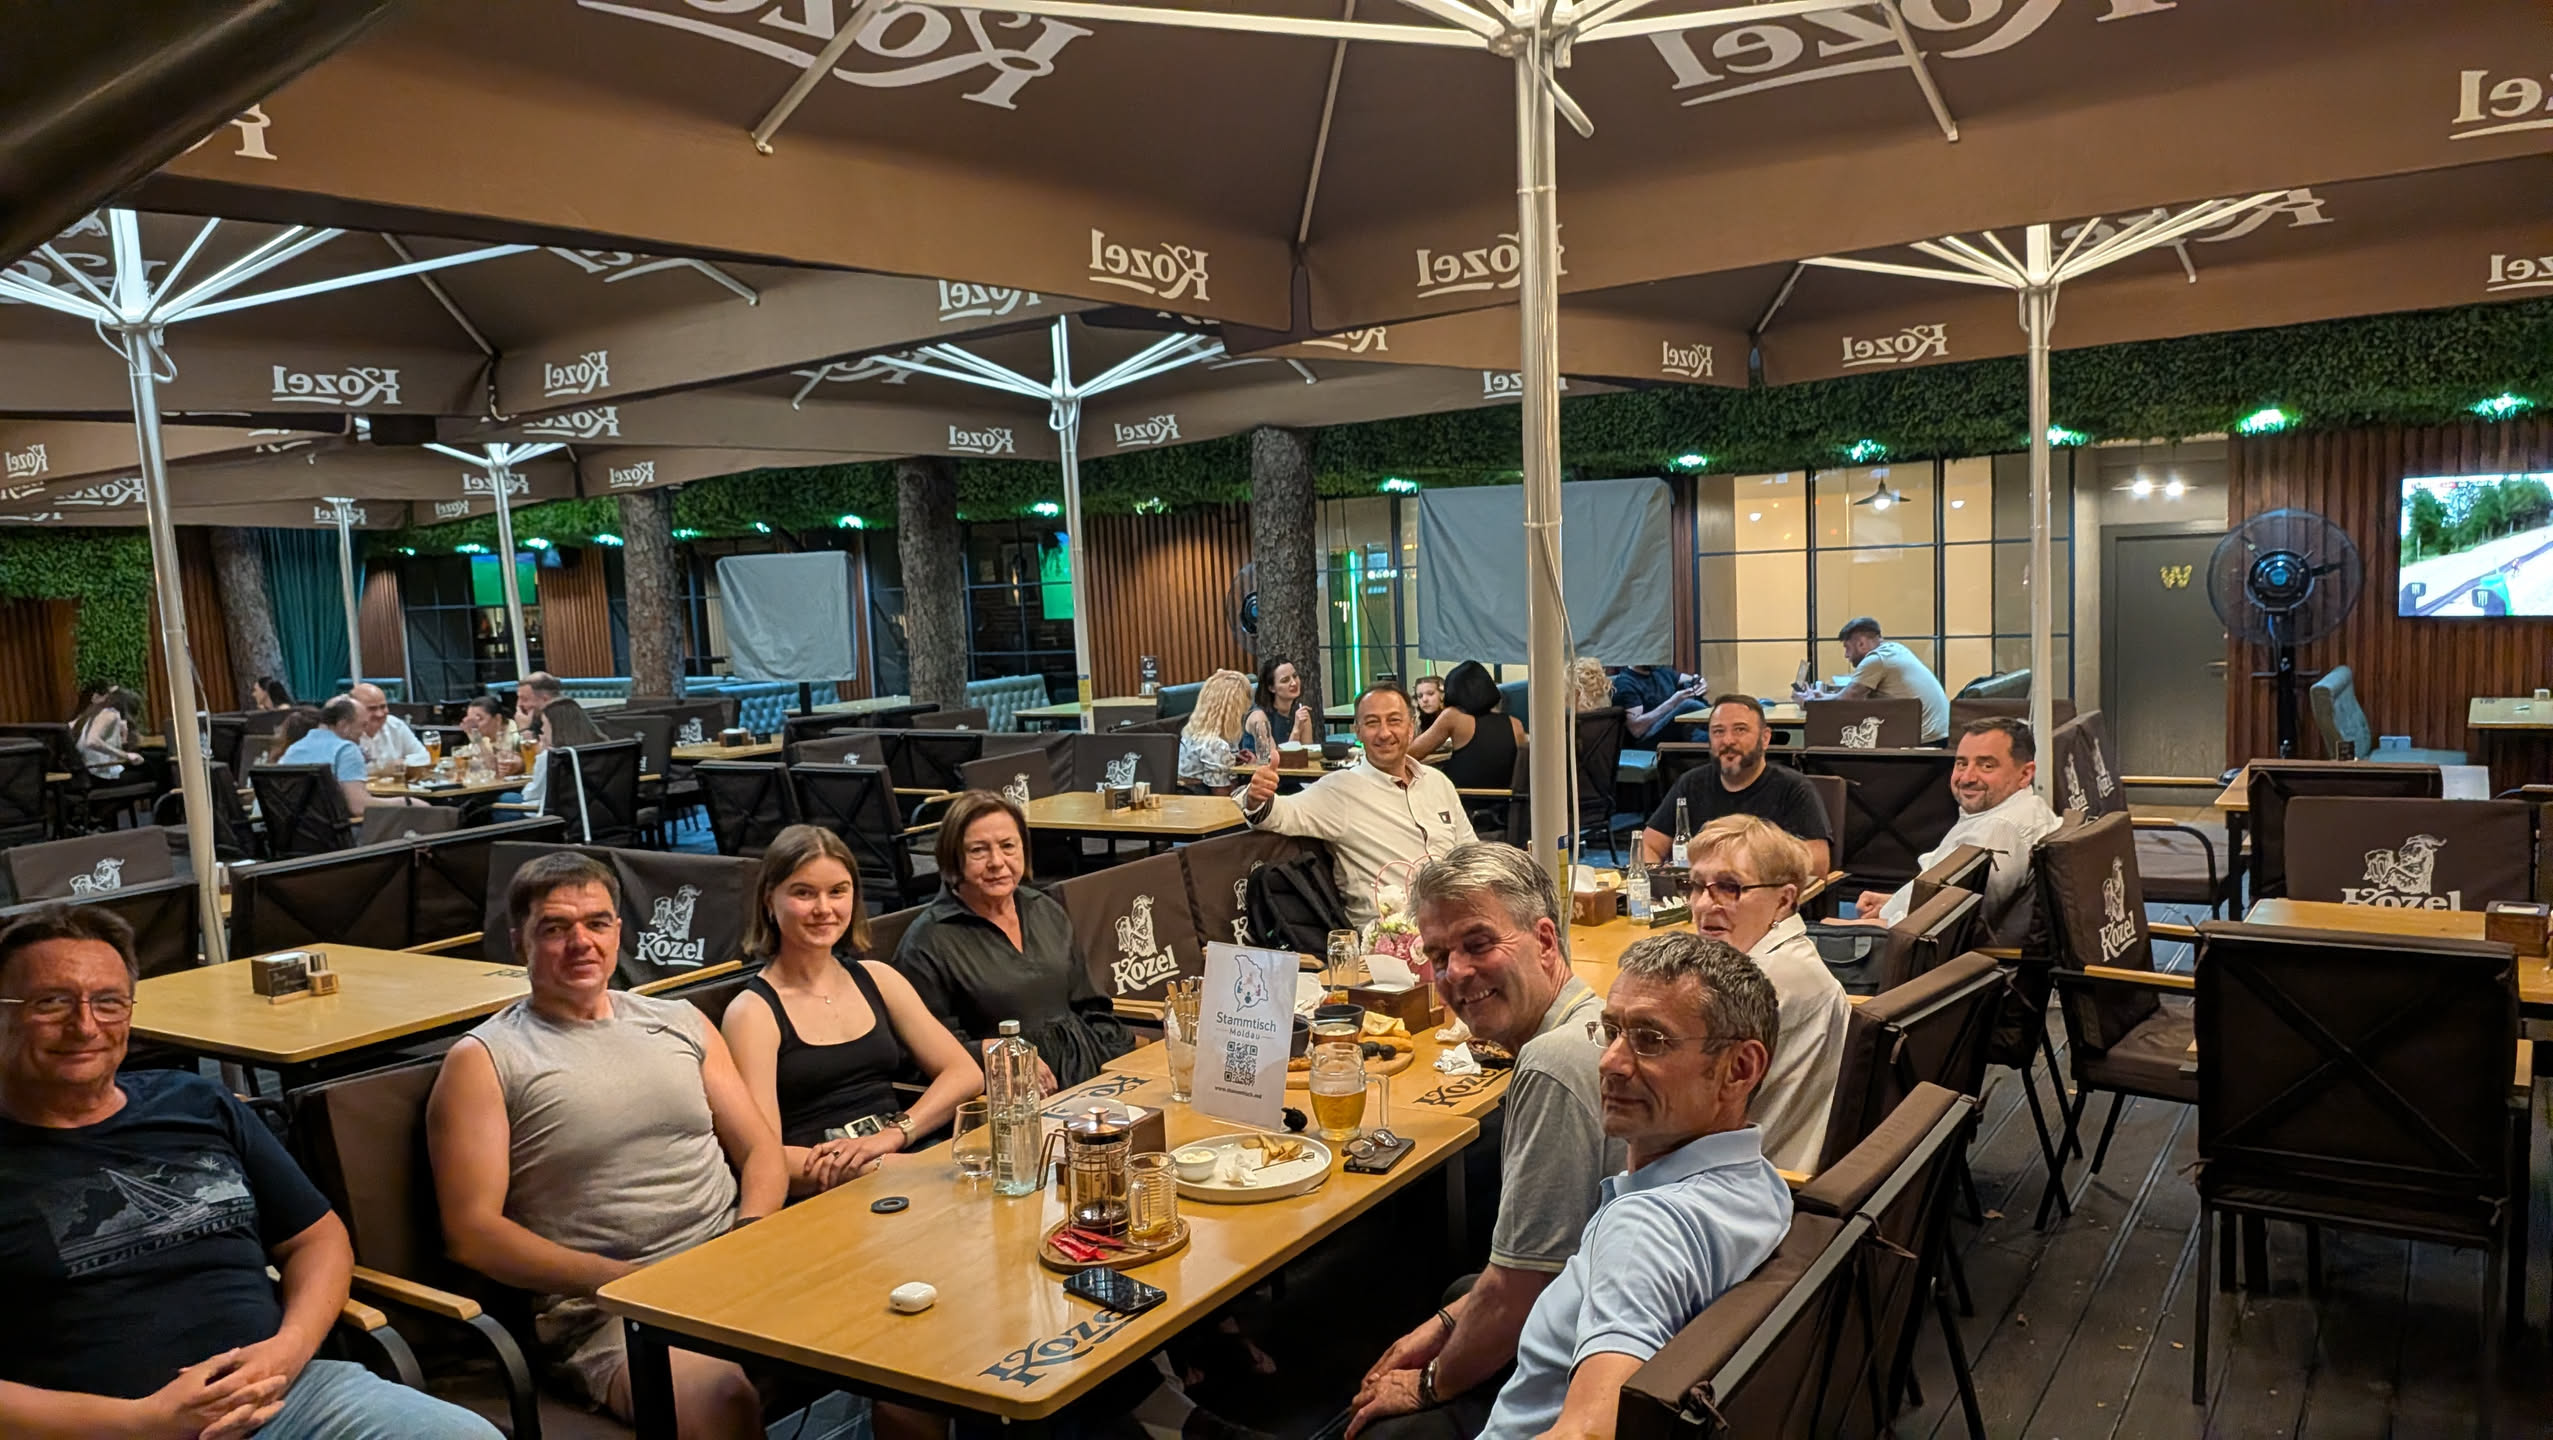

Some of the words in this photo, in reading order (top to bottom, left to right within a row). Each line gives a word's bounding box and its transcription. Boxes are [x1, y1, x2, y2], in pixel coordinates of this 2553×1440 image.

[635, 931, 705, 967] Kozel
[2099, 911, 2138, 963] Kozel
[1110, 944, 1180, 996] Kozel
[1216, 1011, 1277, 1033] Stammtisch
[1229, 1028, 1260, 1040] Moldau
[1412, 1068, 1512, 1107] Koze
[977, 1309, 1141, 1388] Koze
